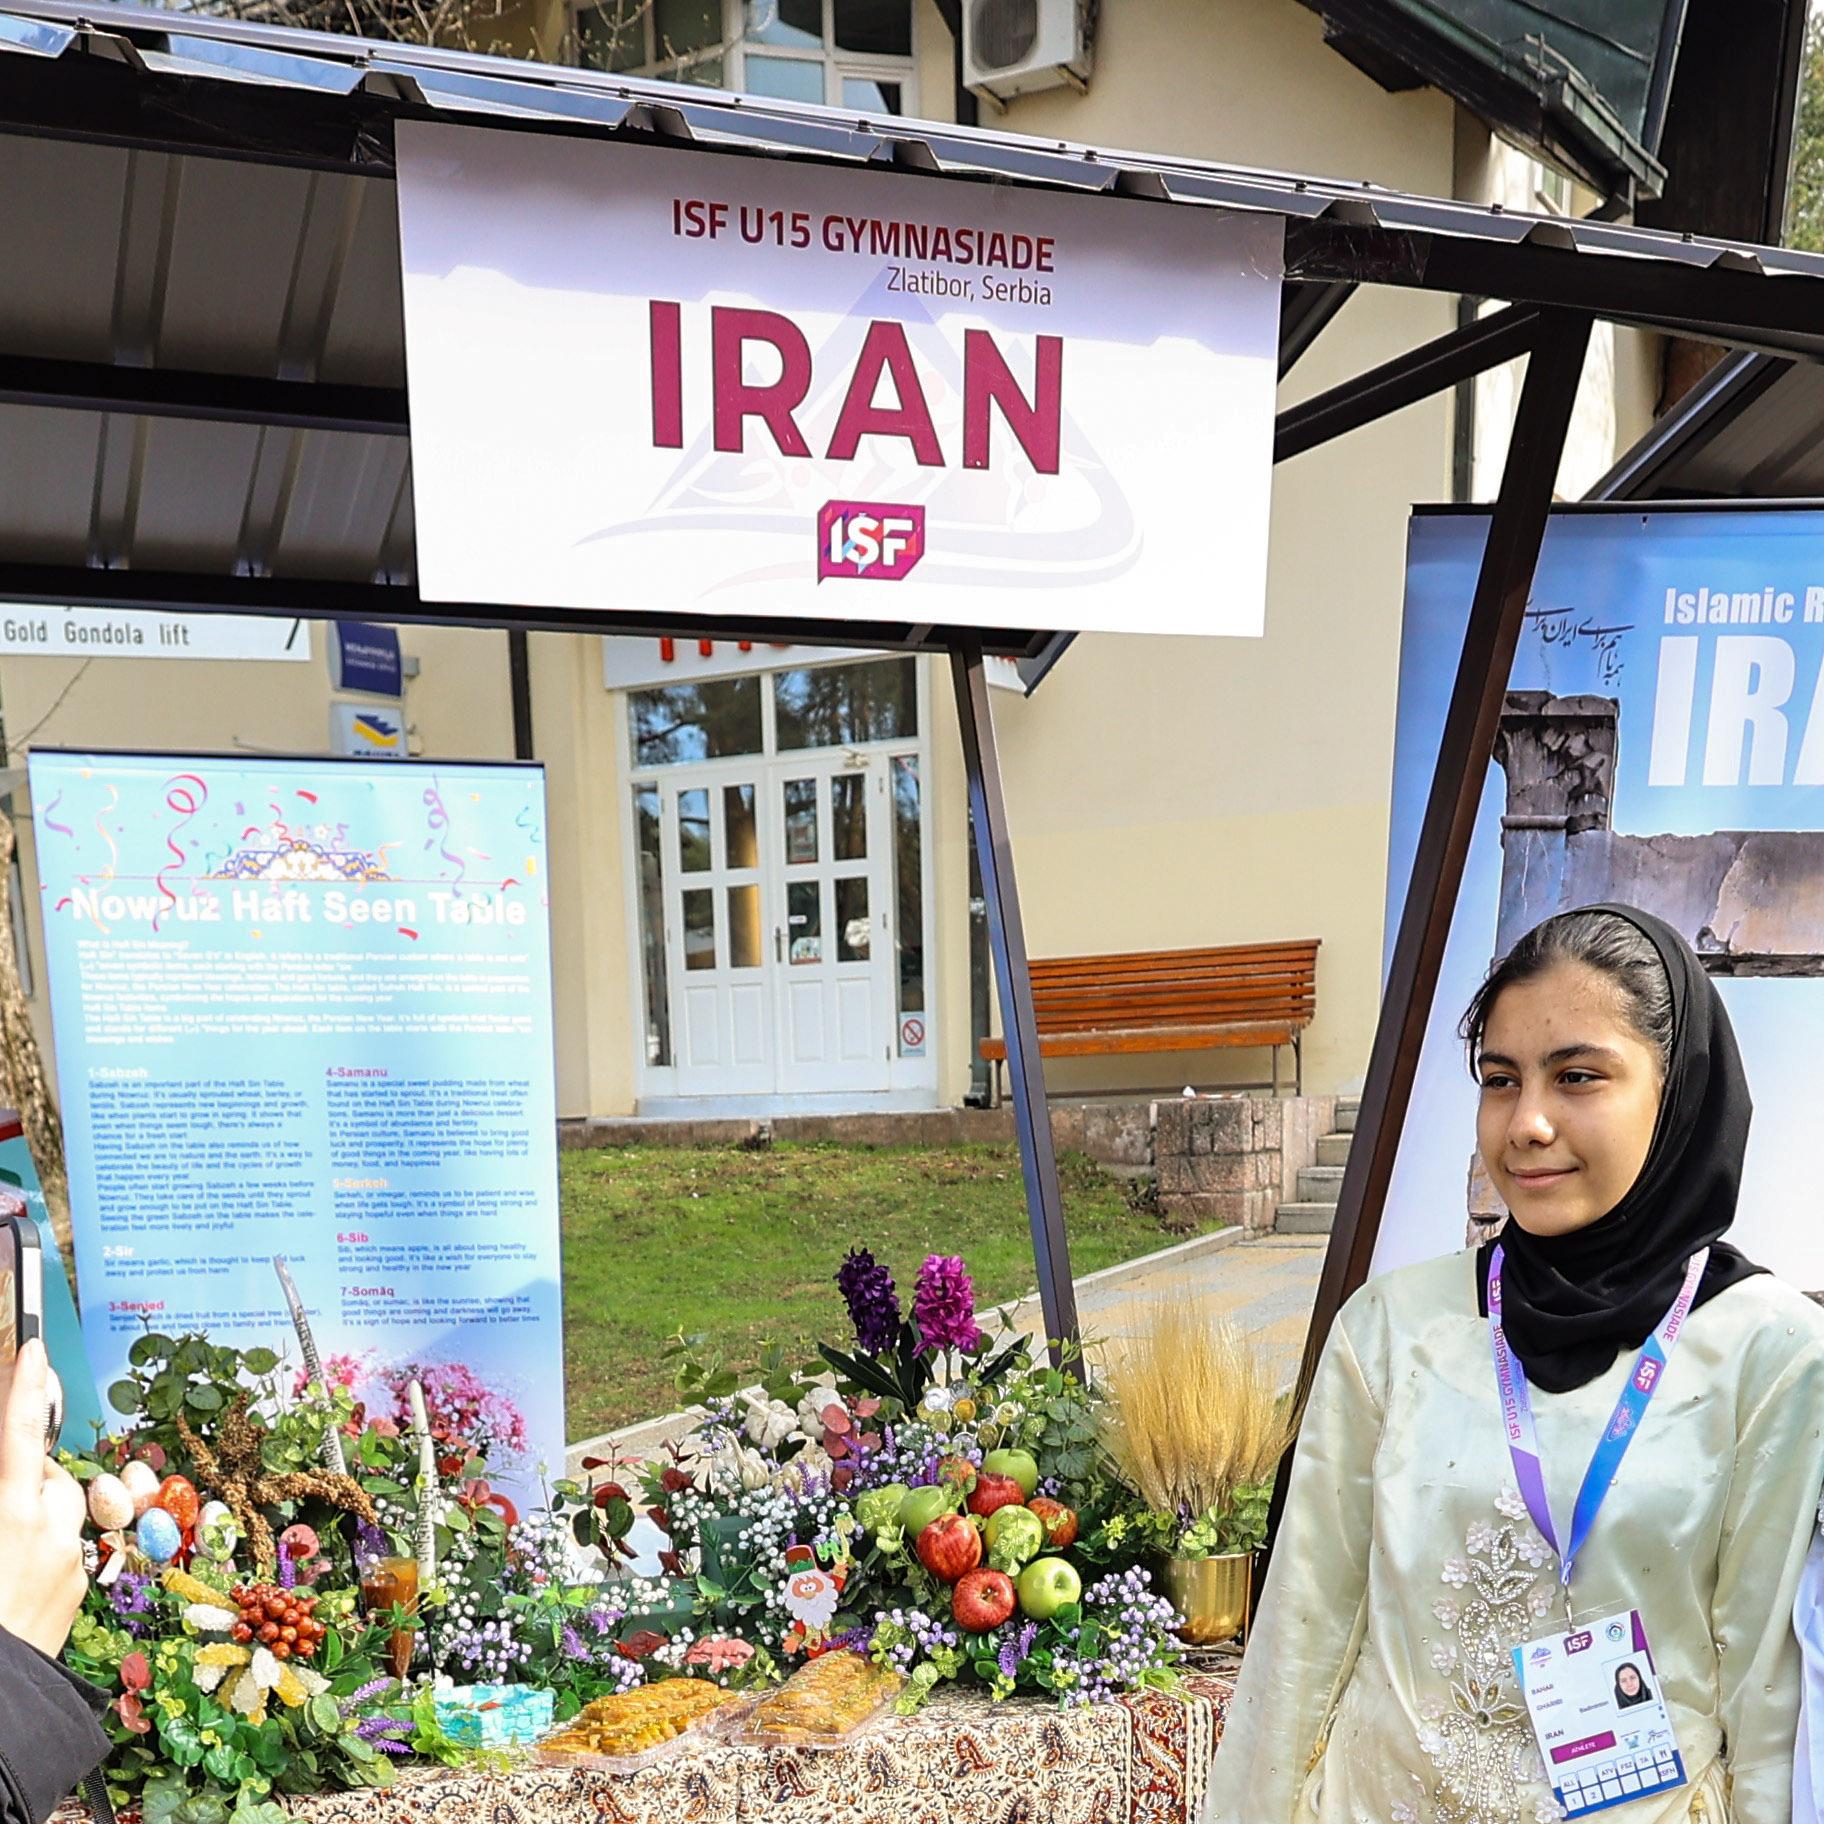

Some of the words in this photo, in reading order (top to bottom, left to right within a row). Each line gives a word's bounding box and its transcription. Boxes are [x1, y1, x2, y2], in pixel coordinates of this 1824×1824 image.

[672, 198, 728, 240] ISF
[739, 205, 812, 248] U15
[822, 215, 1055, 273] GYMNASIADE
[886, 266, 976, 301] Zlatibor,
[982, 275, 1053, 306] Serbia
[649, 299, 1064, 476] IRAN
[830, 513, 914, 567] ISF
[1664, 587, 1793, 625] Islamic
[4, 620, 47, 643] Gold
[64, 621, 143, 646] Gondola
[159, 623, 190, 646] lift
[72, 888, 221, 924] Nowruz
[233, 888, 311, 923] Haft
[322, 890, 417, 924] Seen
[429, 891, 528, 925] Table
[325, 1067, 388, 1078] 4-Samanu
[336, 1232, 369, 1243] 6-Sib
[1493, 1325, 1514, 1397] GYMNASIADE
[1637, 1361, 1657, 1390] ISF
[1505, 1398, 1518, 1421] U15
[1509, 1423, 1521, 1440] ISF
[1567, 1635, 1590, 1652] ISF
[1545, 1729, 1564, 1740] IRAN
